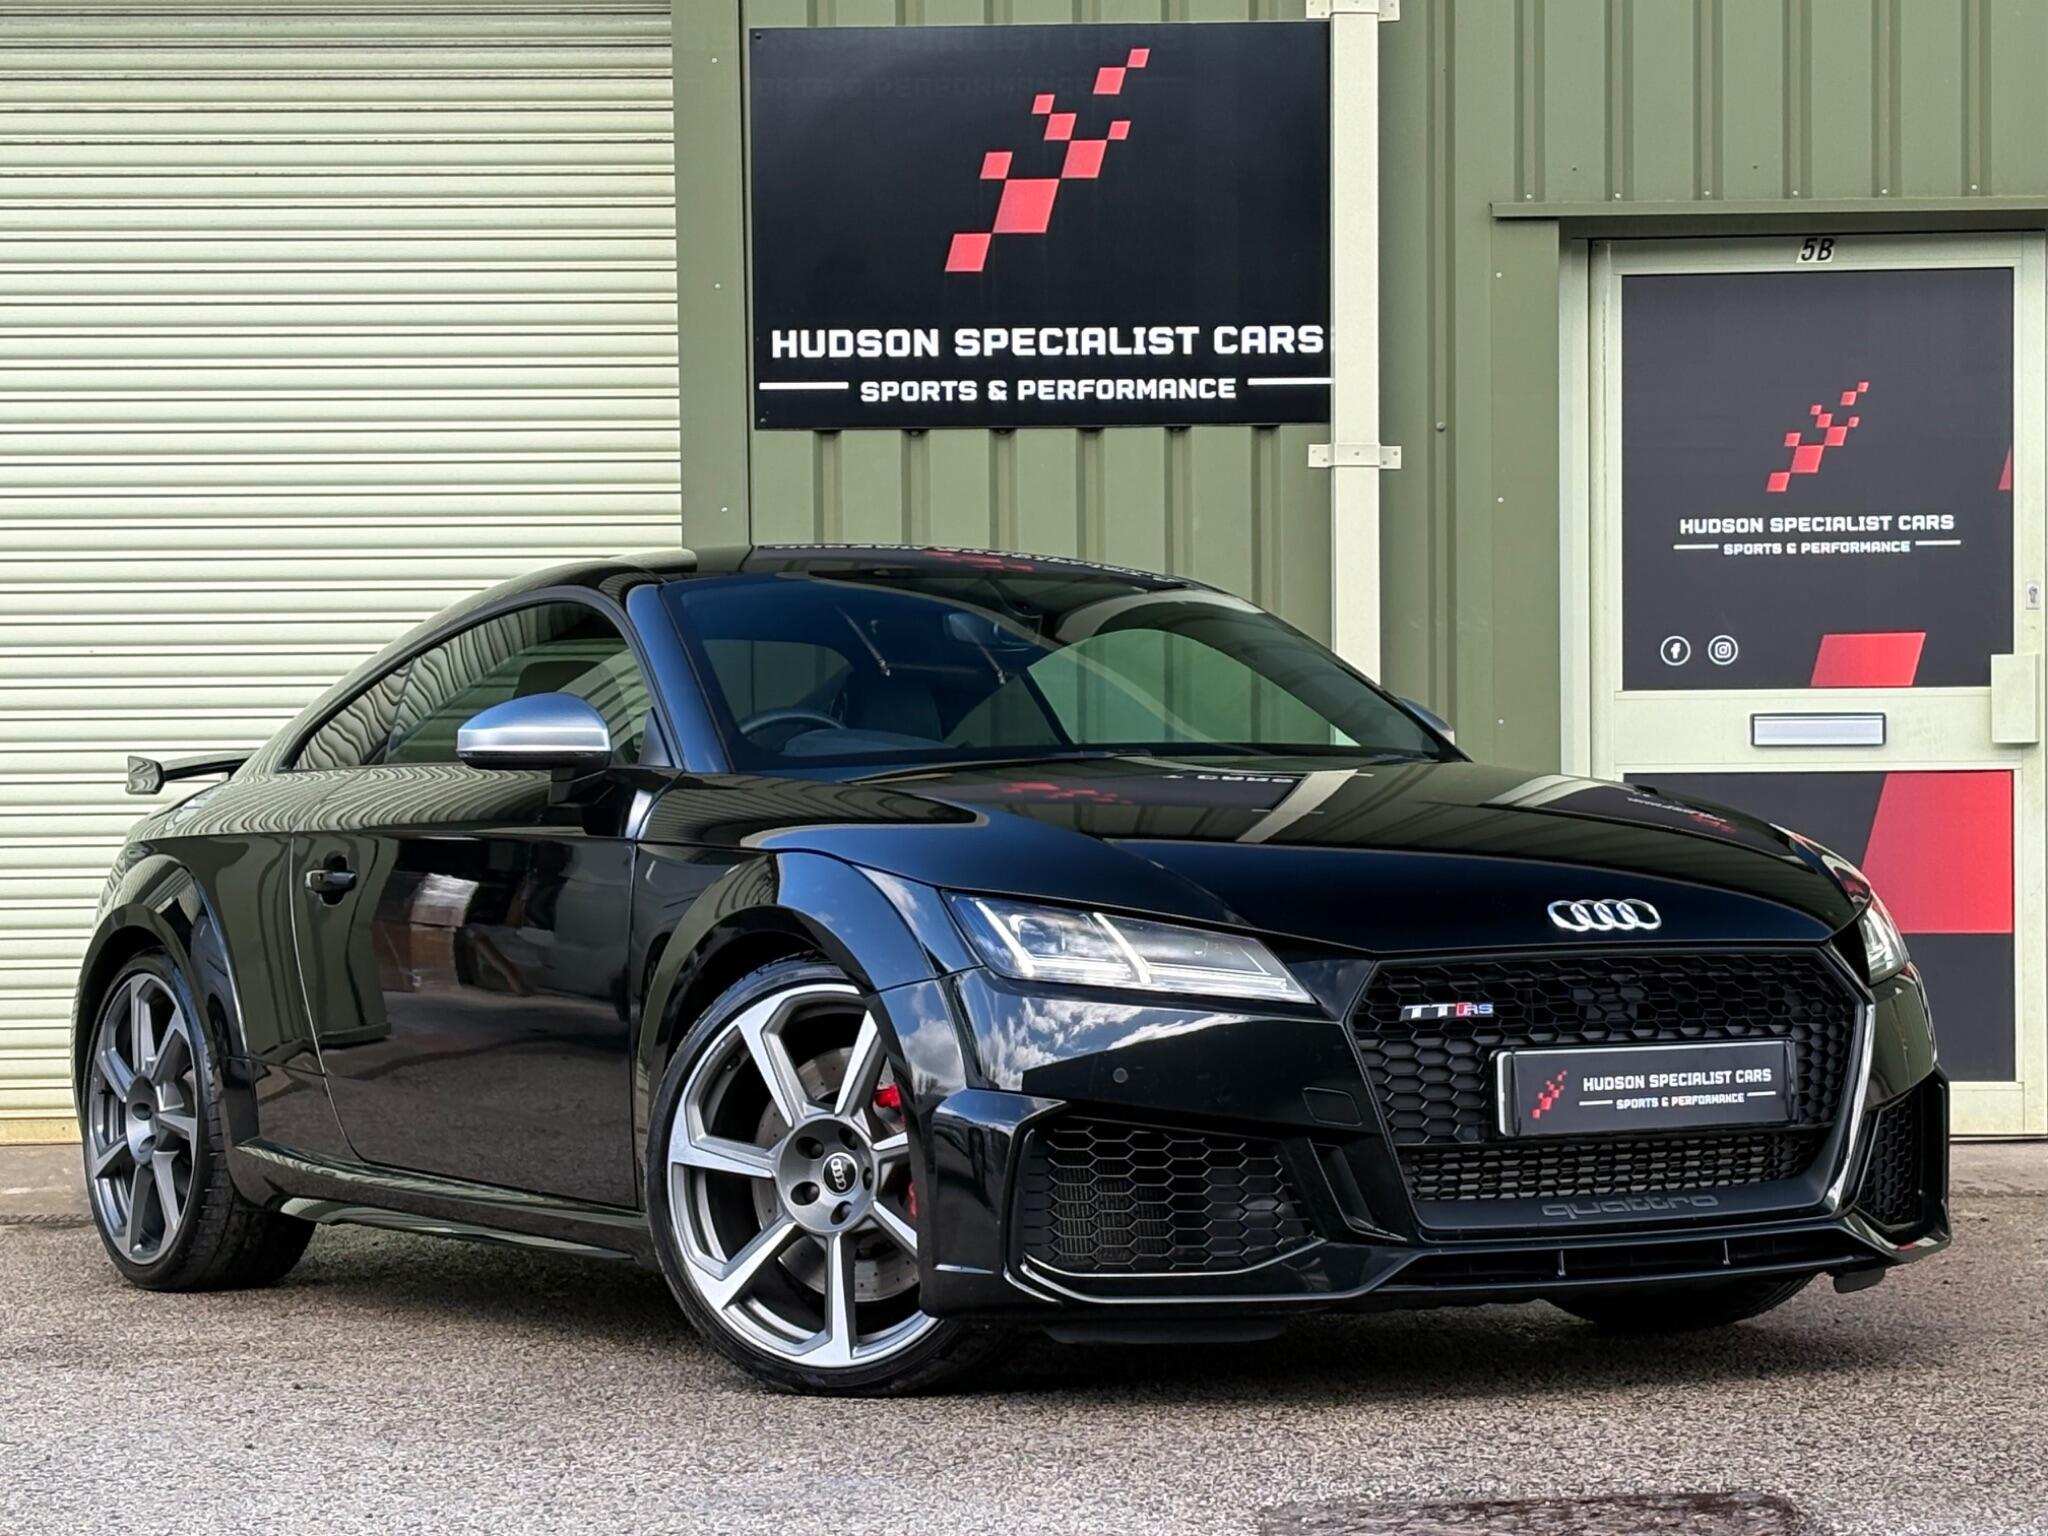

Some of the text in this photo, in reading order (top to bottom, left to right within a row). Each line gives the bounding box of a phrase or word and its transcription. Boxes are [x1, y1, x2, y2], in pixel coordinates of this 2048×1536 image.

[1801, 238, 1835, 261] 5B
[771, 325, 1323, 358] HUDSON SPECIALIST CARS
[860, 378, 1236, 402] SPORTS & PERFORMANCE
[1680, 514, 1954, 534] HUDSON SPECIALIST CARS
[1723, 541, 1911, 555] SPORTS & PERFORMANCE
[1583, 1068, 1772, 1091] HUDSON SPECIALIST CARS
[1616, 1098, 1659, 1110] SPORTS
[1671, 1093, 1745, 1107] PERFORMANCE
[1542, 1195, 1719, 1219] quattro
